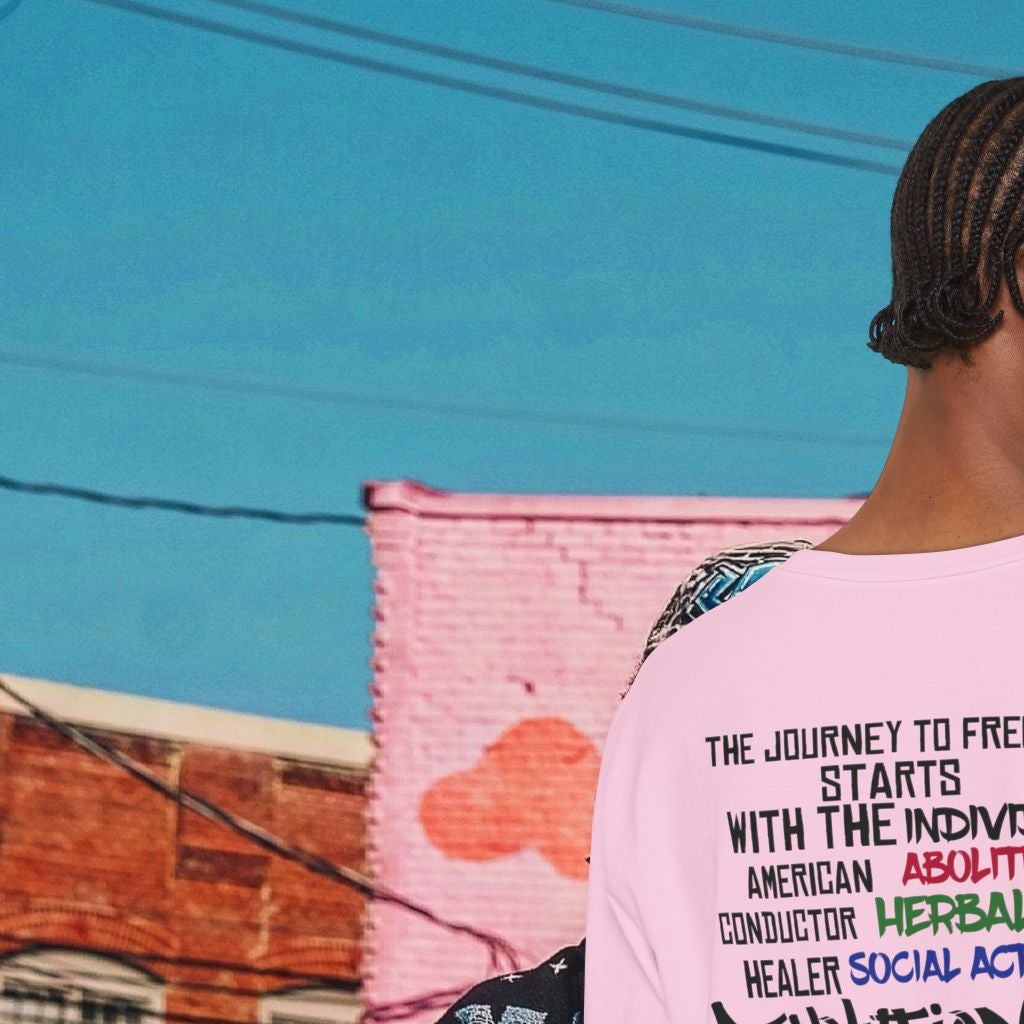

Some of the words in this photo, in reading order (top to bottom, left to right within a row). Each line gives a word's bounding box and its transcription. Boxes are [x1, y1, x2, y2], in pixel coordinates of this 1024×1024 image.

[705, 733, 756, 767] THE
[764, 721, 903, 763] JOURNEY
[914, 718, 951, 752] TO
[820, 759, 962, 802] STARTS
[726, 806, 806, 854] WITH
[816, 802, 898, 850] THE
[747, 859, 874, 900] AMERICAN
[717, 907, 858, 945] CONDUCTOR
[742, 956, 843, 999] HEALER
[848, 947, 962, 986] SOCIAL
